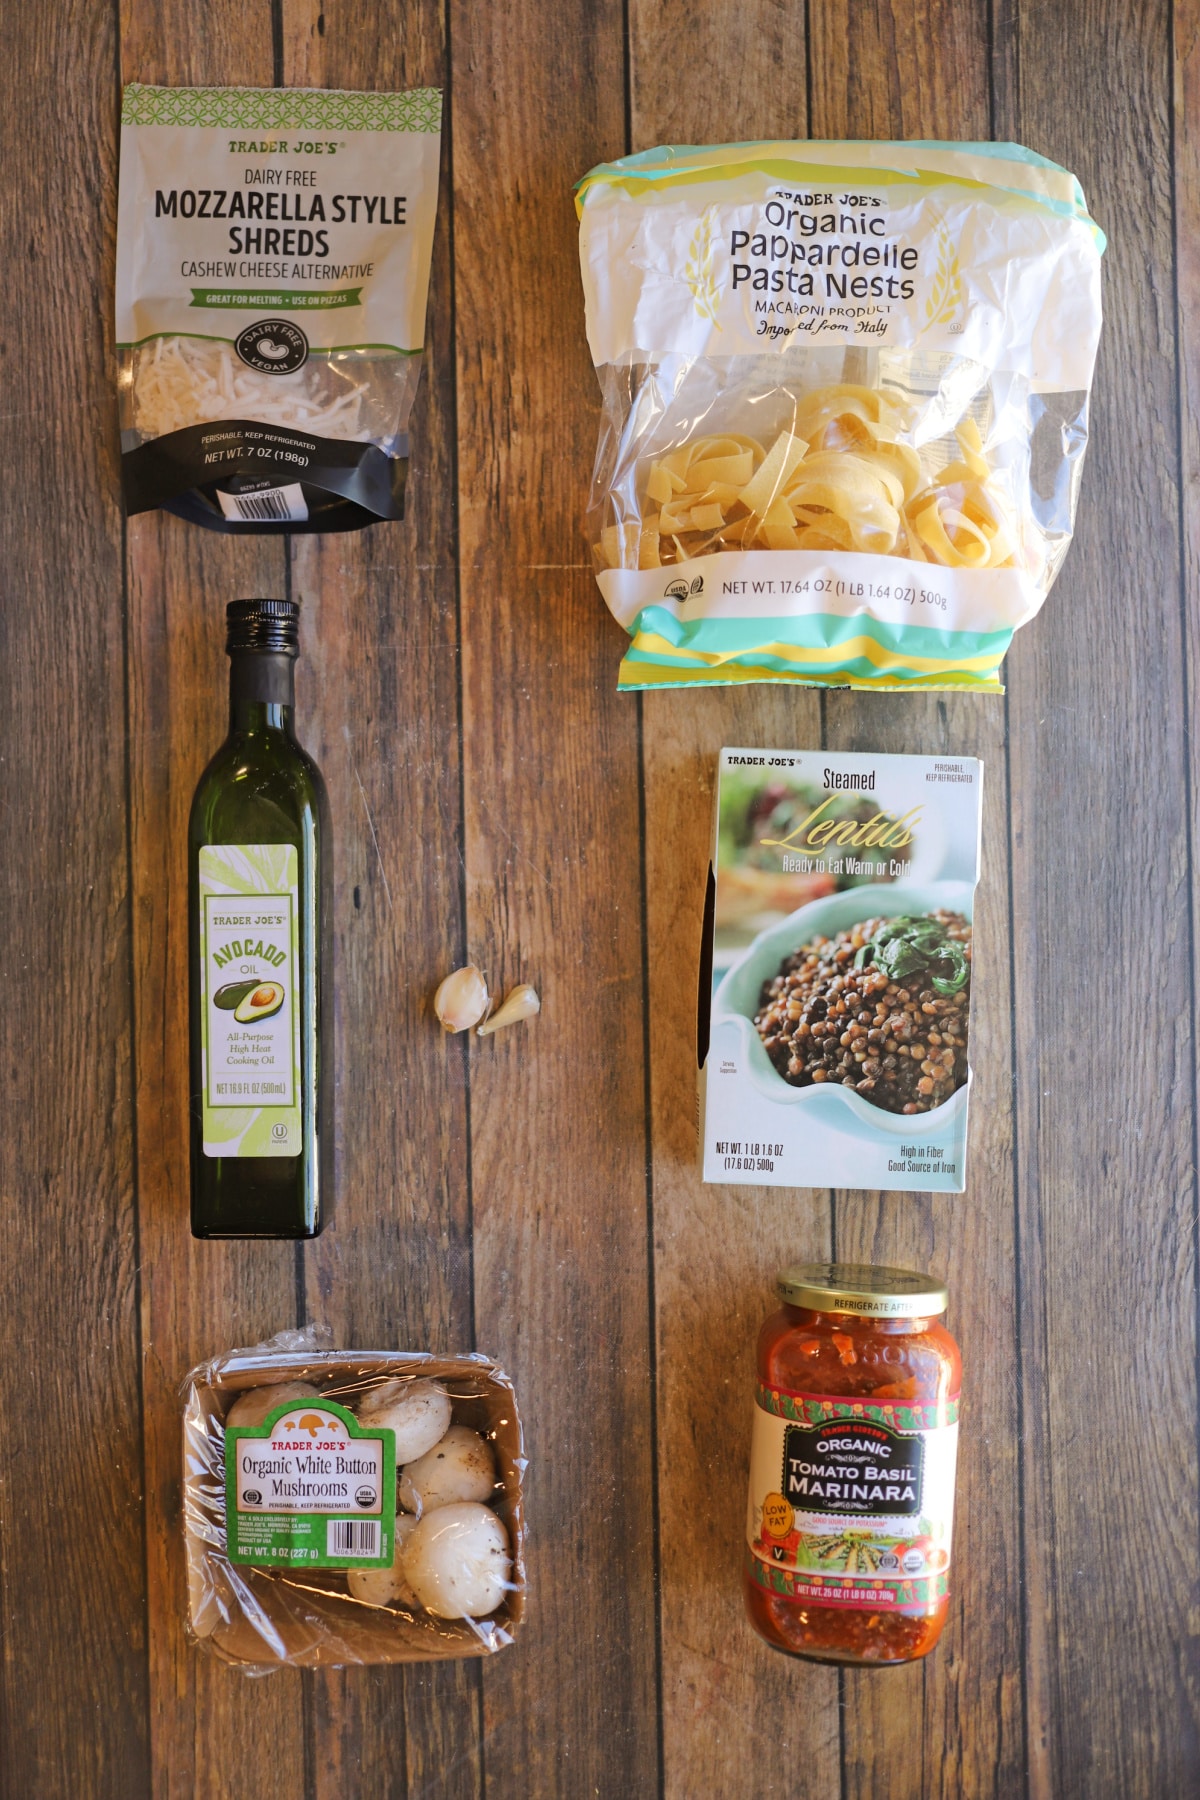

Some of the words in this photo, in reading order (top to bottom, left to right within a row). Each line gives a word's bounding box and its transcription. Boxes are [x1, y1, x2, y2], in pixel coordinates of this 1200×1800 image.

[228, 141, 288, 154] TRADER
[293, 141, 337, 155] JOE'S
[245, 169, 282, 185] DAIRY
[285, 170, 317, 187] FREE
[155, 190, 326, 222] MOZZARELLA
[331, 194, 407, 225] STYLE
[839, 194, 881, 207] JOE'S
[765, 201, 886, 237] Organic
[228, 226, 330, 257] SHREDS
[730, 230, 918, 270] Pappardelle
[181, 261, 237, 278] CASHEW
[239, 262, 289, 279] CHEESE
[291, 263, 375, 280] ALTERNATIVE
[732, 264, 814, 296] Pasta
[825, 273, 915, 300] Nests
[206, 294, 230, 304] GREAT
[231, 295, 248, 305] FOR
[248, 295, 283, 305] MELTING
[292, 295, 307, 305] USE
[307, 295, 319, 305] ON
[320, 294, 347, 305] PIZZAS
[755, 300, 824, 316] MACARONI
[829, 305, 891, 318] PRODUCT
[244, 325, 280, 343] DAIRY
[281, 326, 302, 347] FREE
[757, 318, 814, 339] Impored
[812, 319, 849, 337] from
[854, 318, 888, 338] Italy
[251, 357, 288, 371] VEGAN
[245, 431, 264, 440] KEEP
[264, 433, 316, 451] REFRIGERATED
[204, 450, 225, 464] NET
[226, 448, 244, 461] WT.
[247, 447, 254, 457] 7
[257, 447, 272, 458] OZ
[274, 449, 309, 467] (198g)
[722, 581, 748, 595] NET
[752, 581, 776, 594] WT.
[781, 580, 809, 593] 17.64
[814, 579, 832, 592] OZ
[836, 581, 845, 597] (1
[850, 582, 865, 596] LB
[868, 584, 890, 599] 1.64
[894, 585, 915, 605] OZ)
[919, 590, 947, 610] 500g
[727, 756, 765, 766] TRADER
[768, 757, 795, 767] JOE'S
[823, 768, 875, 791] Steamed
[926, 773, 937, 782] KEEP
[938, 774, 973, 783] REFRIGERATED
[759, 791, 926, 855] Lentils
[782, 855, 813, 875] Ready
[815, 857, 825, 873] to
[828, 857, 844, 874] Eat
[845, 858, 873, 875] Warm
[876, 862, 886, 875] or
[889, 860, 911, 877] Cold
[213, 916, 252, 926] TRADER
[254, 916, 282, 925] JOE'S
[212, 939, 287, 969] AVOCADO
[240, 965, 259, 974] OIL
[227, 1033, 274, 1042] All-Purpose
[230, 1045, 249, 1054] High
[252, 1045, 271, 1053] Heat
[226, 1056, 259, 1066] Cooking
[261, 1056, 274, 1064] Oil
[217, 1083, 228, 1094] NET
[230, 1083, 242, 1094] 16.9
[244, 1083, 250, 1094] FL
[252, 1083, 260, 1094] OZ
[261, 1083, 286, 1095] (500mL)
[715, 1142, 728, 1154] NET
[731, 1142, 743, 1154] WT.
[745, 1143, 749, 1155] 1
[750, 1143, 760, 1155] LB
[762, 1143, 773, 1156] 1.6
[774, 1144, 784, 1156] OZ
[900, 1145, 916, 1158] High
[918, 1146, 925, 1157] in
[927, 1146, 944, 1158] Fiber
[724, 1157, 742, 1171] (17.6
[743, 1157, 755, 1171] OZ)
[757, 1158, 774, 1172] 500g
[888, 1160, 905, 1172] Good
[907, 1160, 931, 1173] Source
[933, 1160, 940, 1173] of
[942, 1161, 956, 1174] Iron
[834, 1299, 889, 1312] REFRIGERATE
[271, 1442, 312, 1451] TRADER
[316, 1442, 346, 1451] JOE'S
[816, 1439, 892, 1458] ORGANIC
[242, 1456, 293, 1478] Organic
[296, 1455, 332, 1475] White
[336, 1457, 377, 1475] Button
[272, 1476, 348, 1497] Mushrooms
[765, 1505, 787, 1515] LOW
[769, 1517, 787, 1527] FAT
[238, 1546, 252, 1556] NET
[254, 1547, 269, 1556] WT.
[272, 1547, 277, 1556] 8
[279, 1548, 289, 1557] OZ
[291, 1548, 308, 1559] (227
[310, 1548, 319, 1560] g)
[798, 1584, 809, 1594] NET
[811, 1586, 821, 1596] WT.
[823, 1588, 831, 1598] 25
[833, 1588, 841, 1598] OZ
[851, 1589, 860, 1599] LB
[866, 1590, 876, 1601] OZ)
